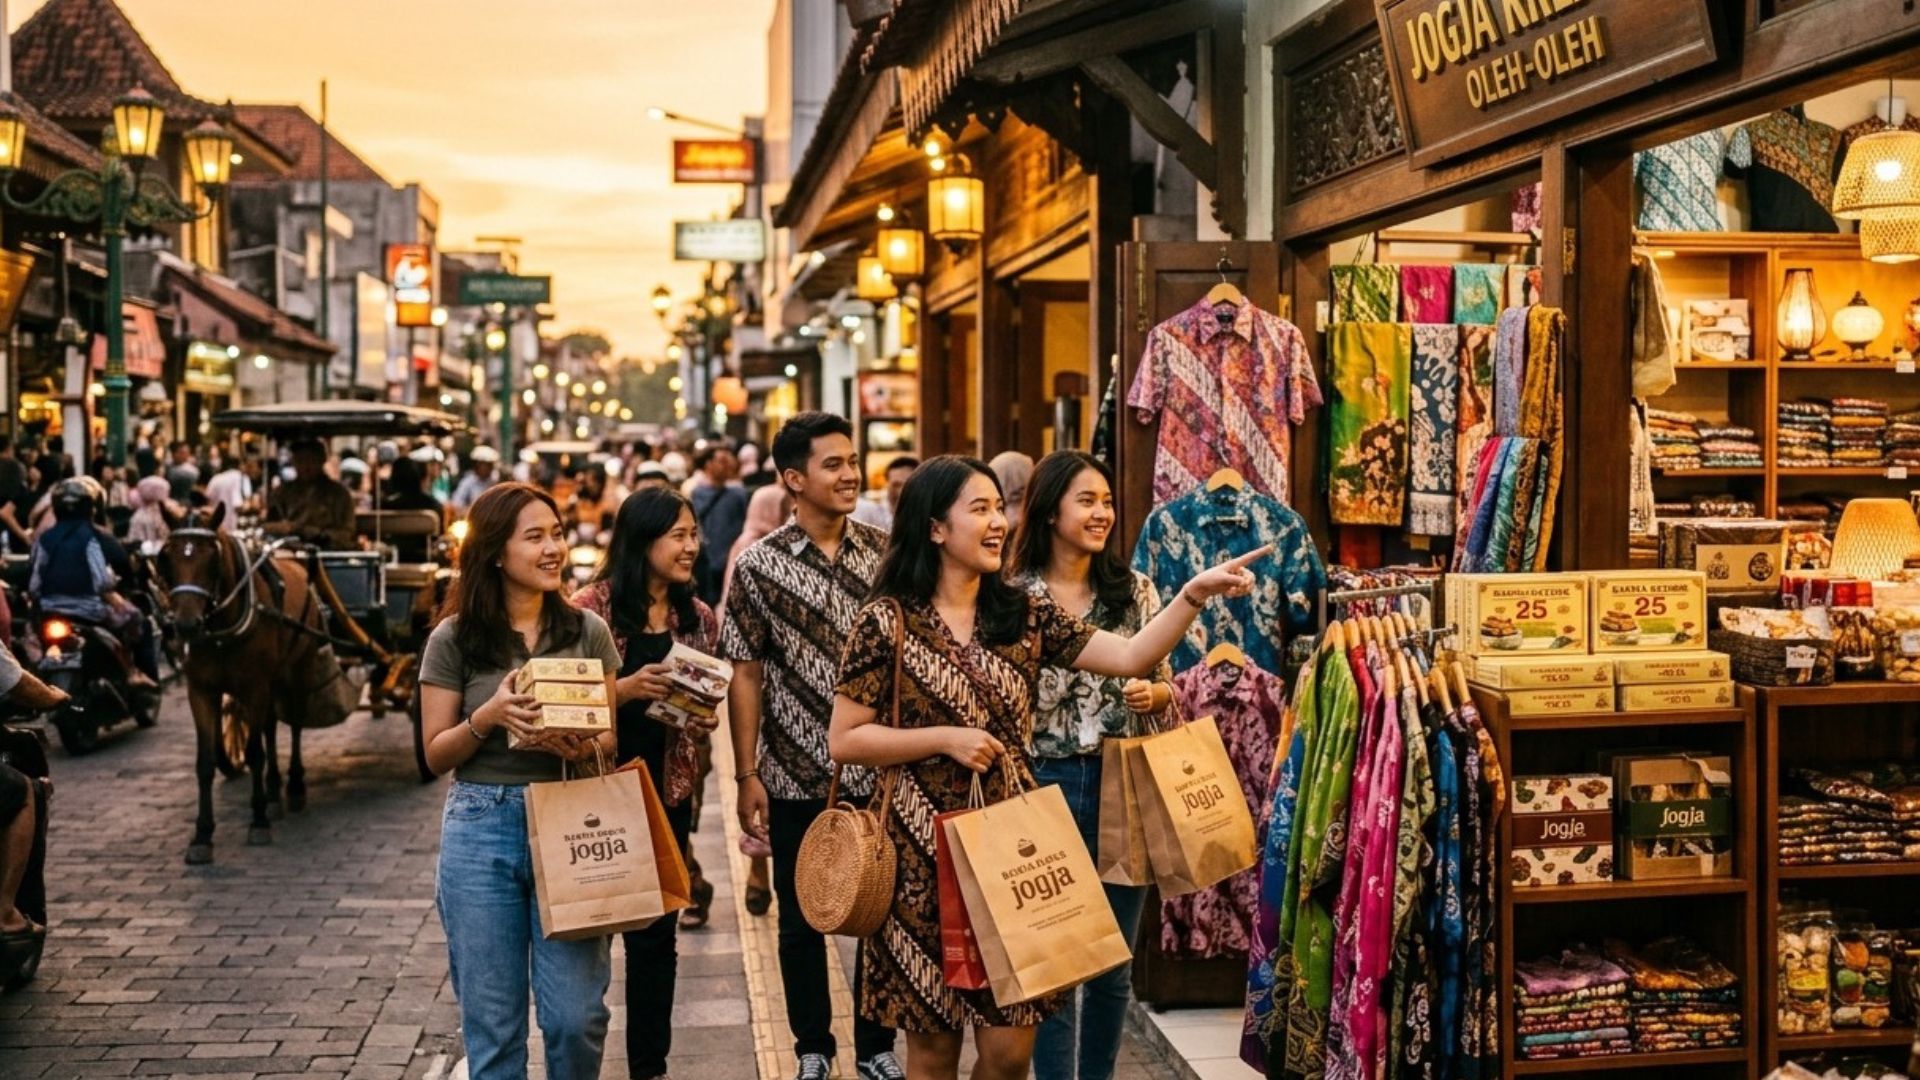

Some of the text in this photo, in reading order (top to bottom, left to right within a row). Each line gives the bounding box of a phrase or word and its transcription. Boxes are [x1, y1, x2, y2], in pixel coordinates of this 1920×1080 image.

[1406, 0, 1499, 80] JOGJA
[1466, 15, 1605, 108] OLEH-OLEH
[1516, 600, 1547, 619] 25
[1635, 596, 1667, 616] 25
[1181, 784, 1224, 817] jogja
[1660, 806, 1705, 827] Jogja
[569, 836, 629, 865] jogja
[1011, 865, 1076, 910] jogja
